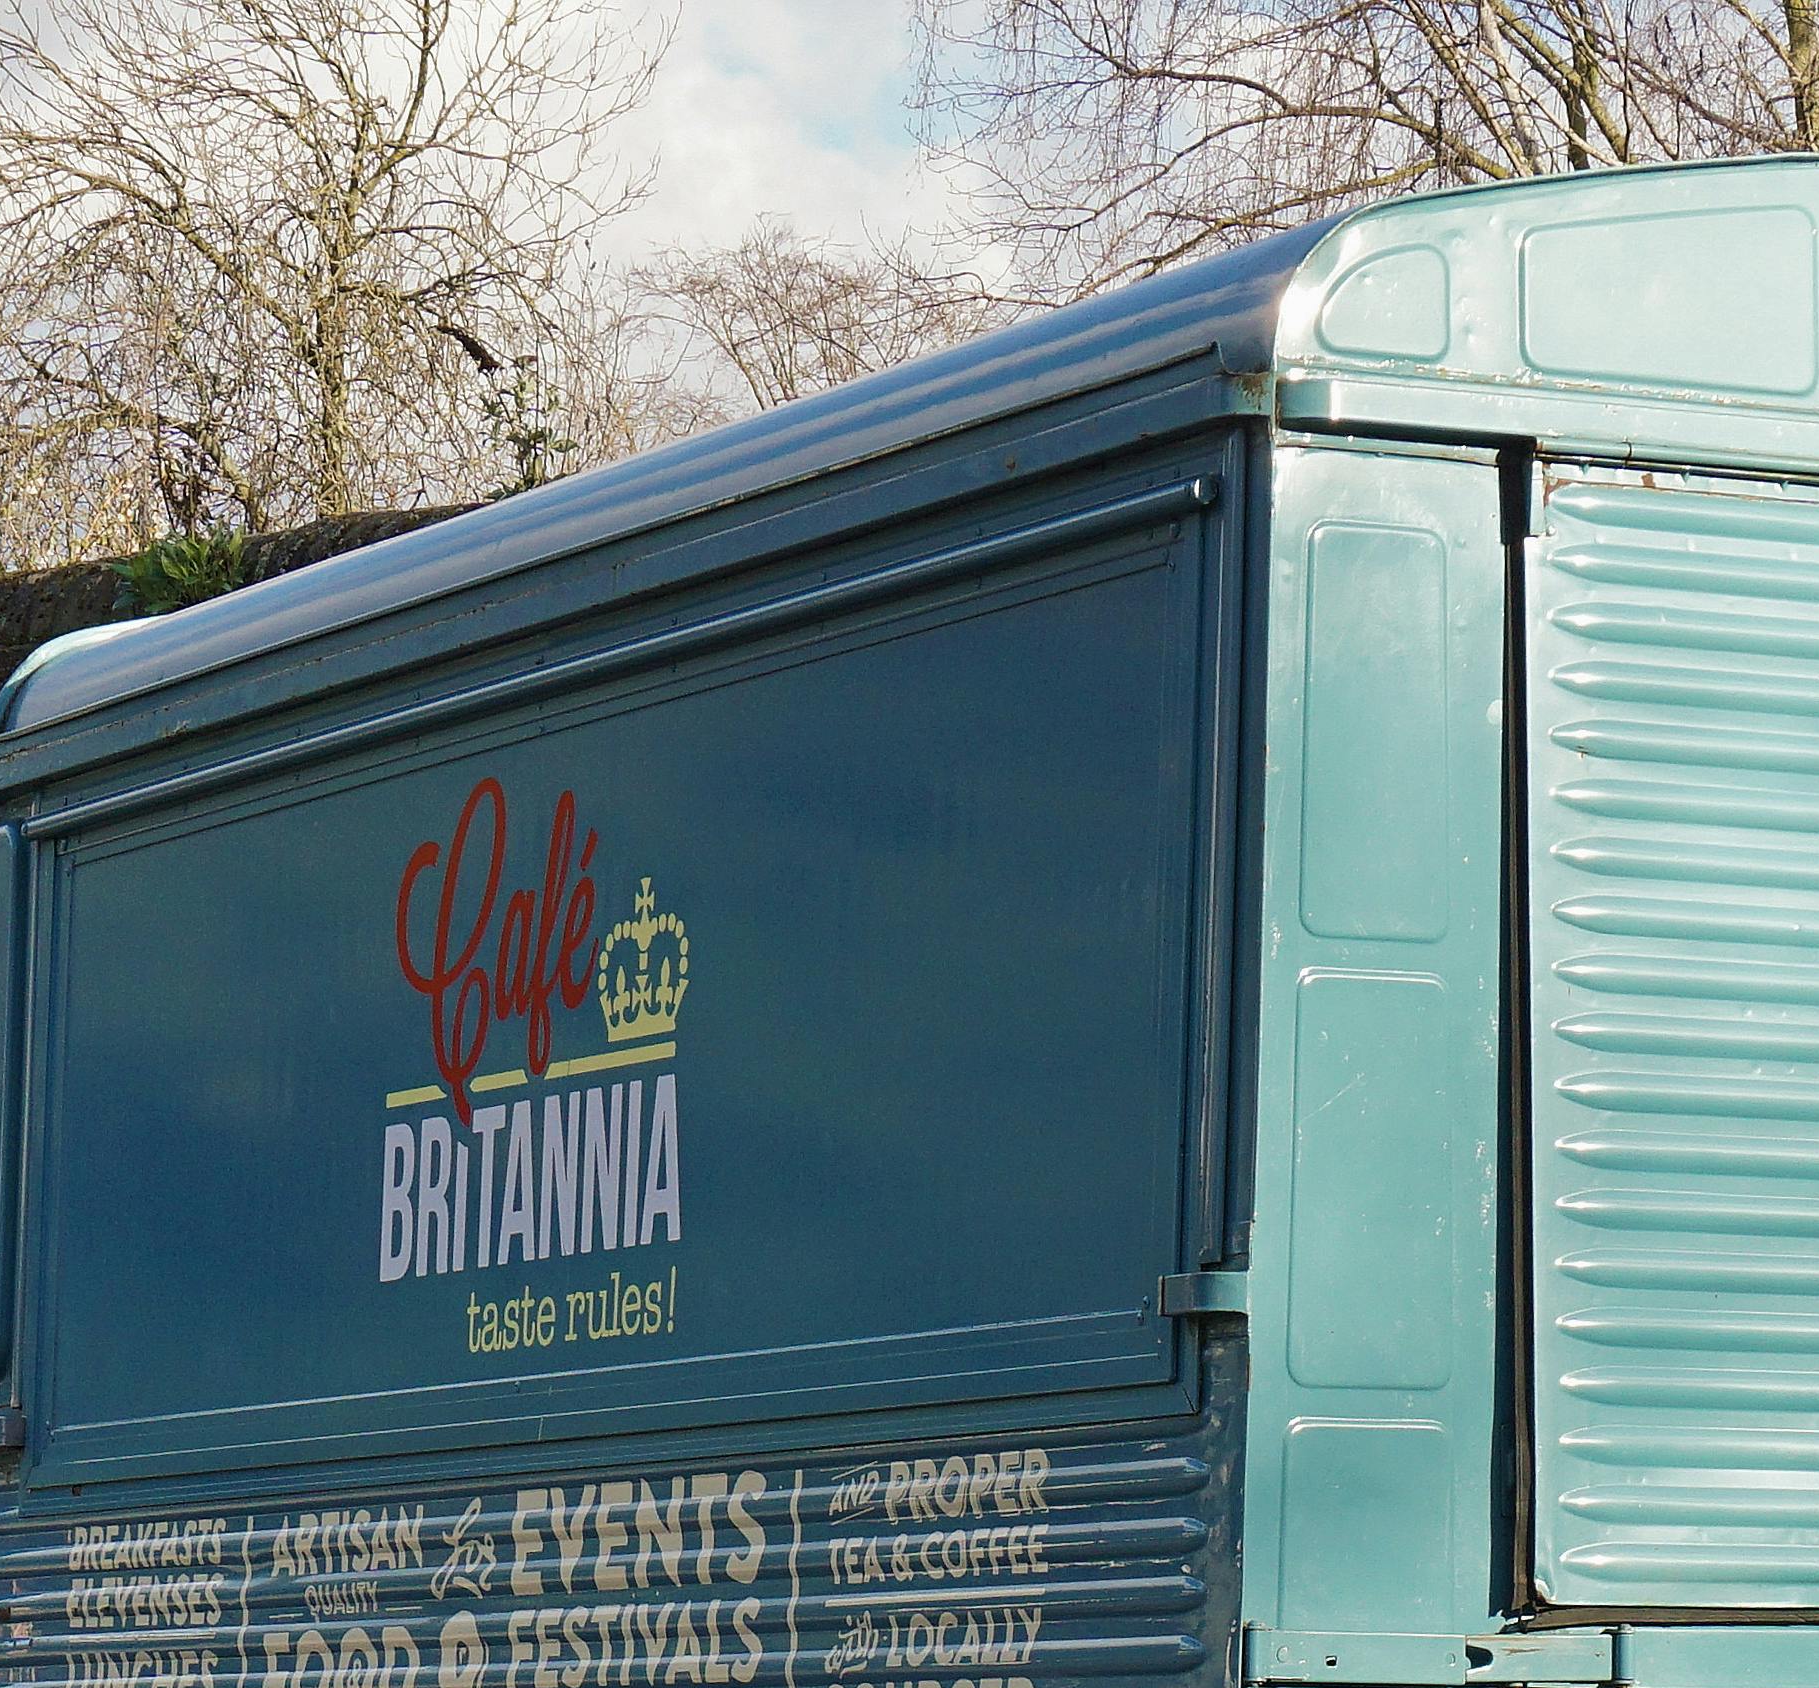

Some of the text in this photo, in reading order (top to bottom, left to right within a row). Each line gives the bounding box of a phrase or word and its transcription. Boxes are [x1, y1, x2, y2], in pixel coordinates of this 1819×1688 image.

[396, 777, 599, 1127] Café
[379, 1074, 683, 1283] BRITANNIA
[467, 1266, 679, 1354] taste rules!
[829, 1448, 1051, 1525] AND PROPER
[67, 1518, 227, 1571] BREAKFASTS
[271, 1504, 424, 1578] ARTISAN
[430, 1470, 767, 1600] for EVENTS
[828, 1524, 1050, 1585] TEA & COFFEE
[66, 1572, 224, 1628] ELEVENSES
[304, 1580, 378, 1623] QUALITY
[885, 1606, 1042, 1669] LOCALLY
